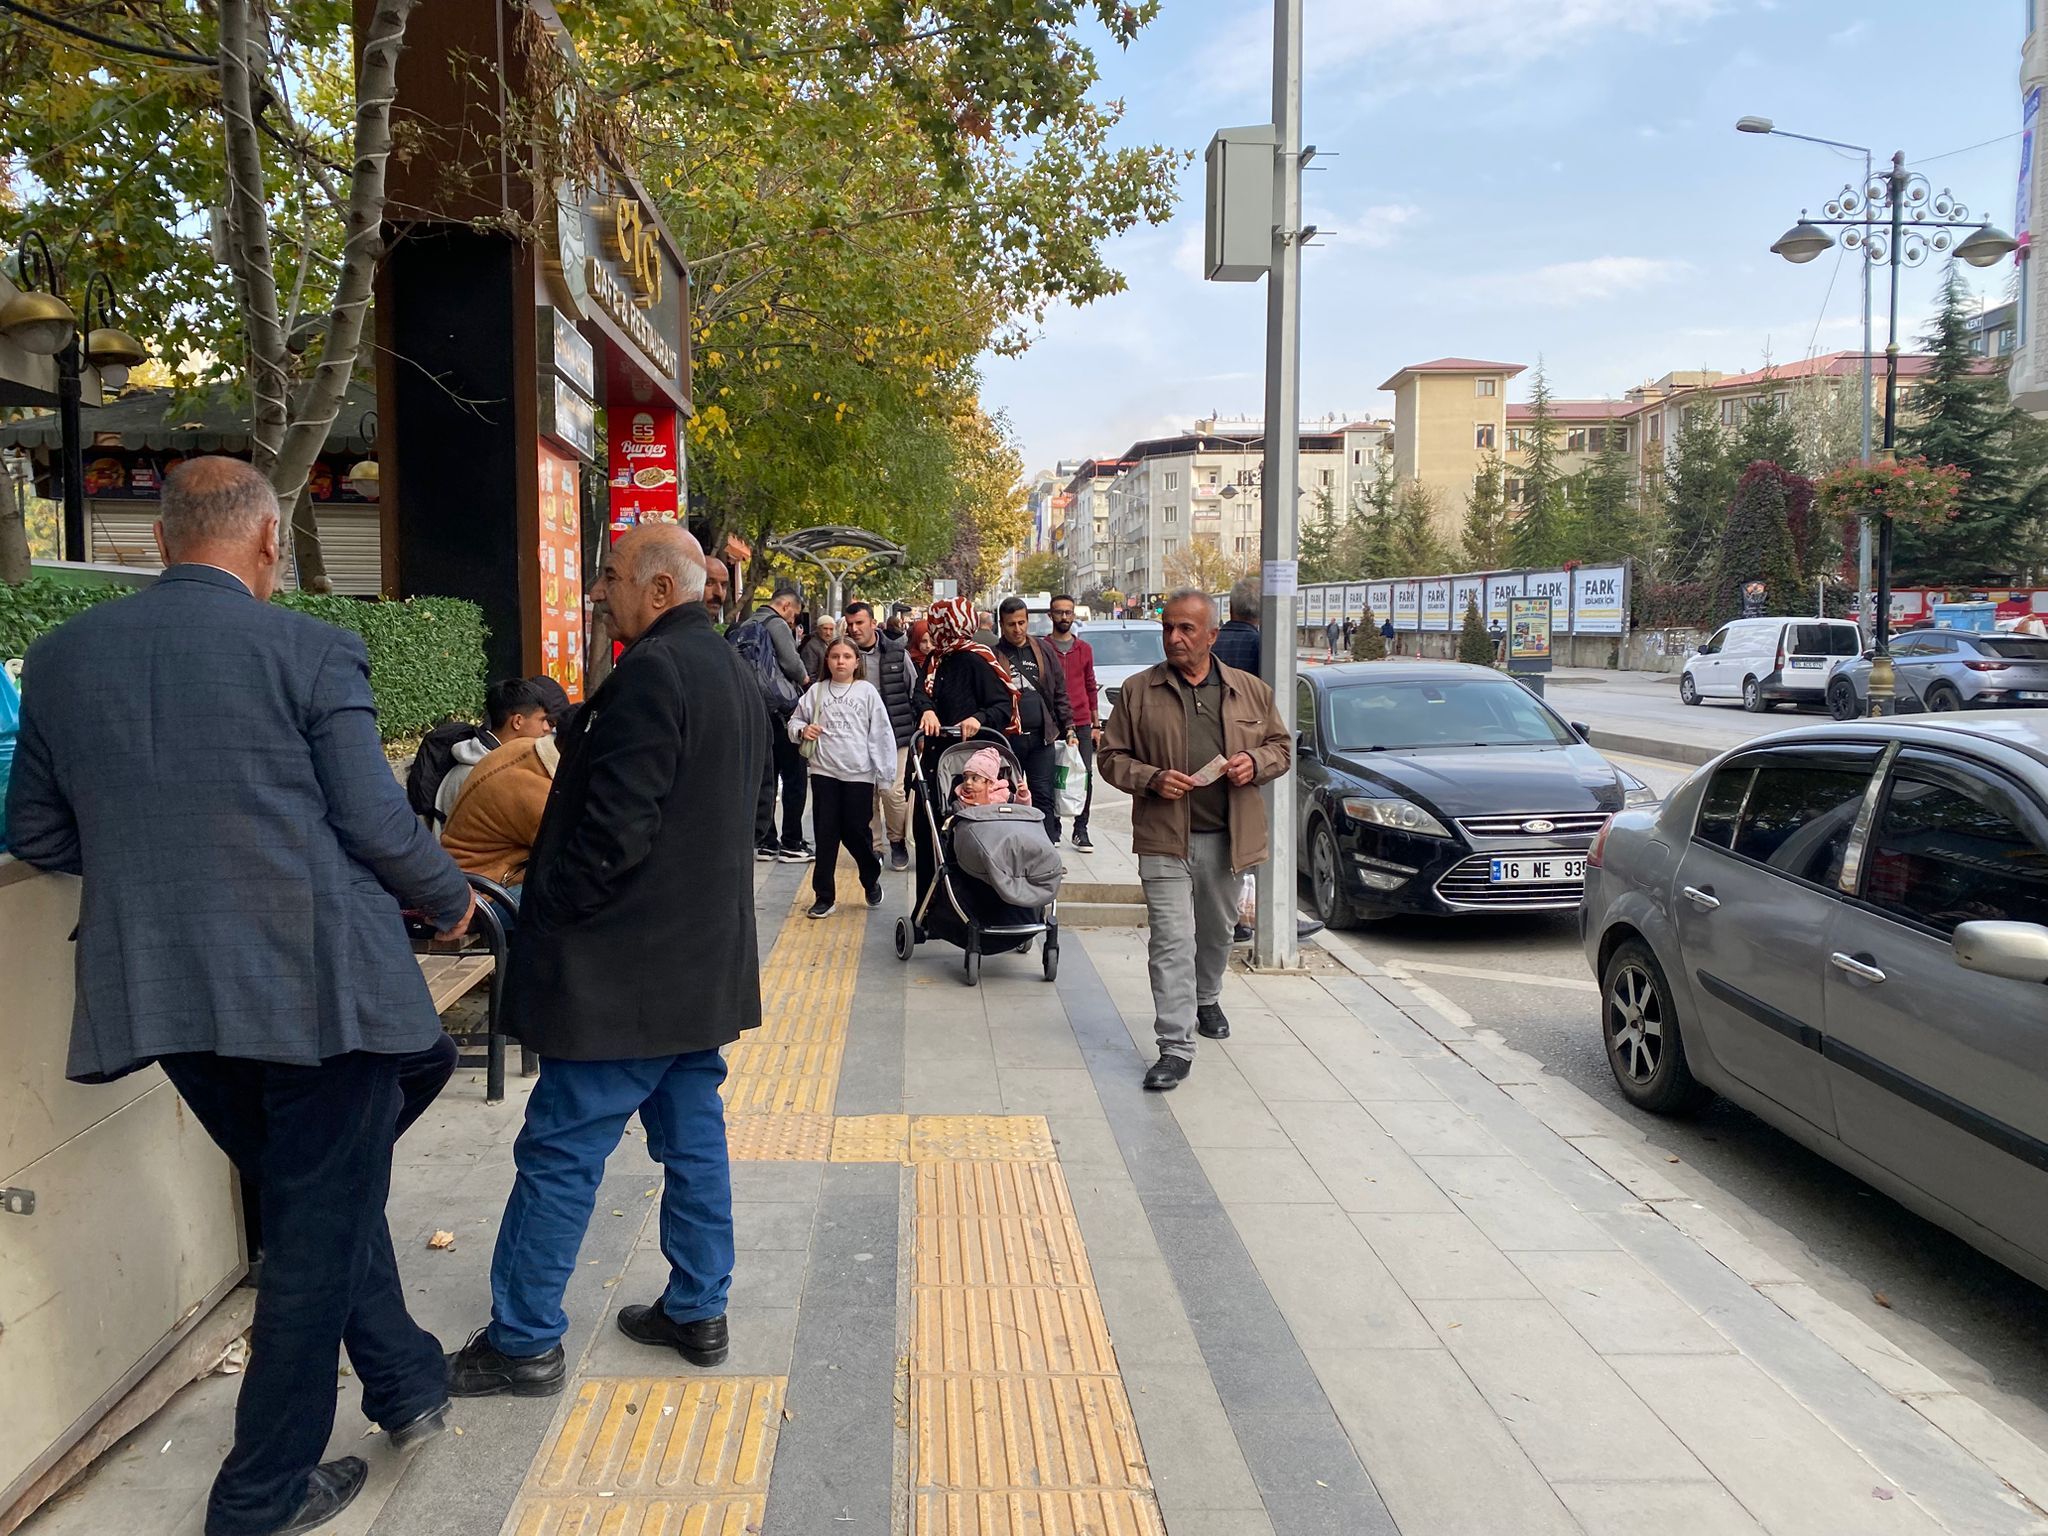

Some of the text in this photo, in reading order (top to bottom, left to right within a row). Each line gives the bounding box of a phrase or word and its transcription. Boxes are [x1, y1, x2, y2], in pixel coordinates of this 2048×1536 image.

[594, 257, 620, 316] CAFE
[630, 300, 677, 379] RESTAURANT
[633, 424, 654, 436] ES
[621, 440, 667, 460] Burger
[1495, 585, 1517, 599] FARK
[1537, 582, 1562, 597] FARK
[1585, 579, 1615, 595] FARK
[1373, 592, 1387, 602] FARK
[1399, 591, 1415, 602] FARK
[1428, 589, 1445, 602] FARK
[820, 697, 861, 716] ALABASAS
[1503, 863, 1519, 879] 16
[1533, 862, 1551, 878] NE
